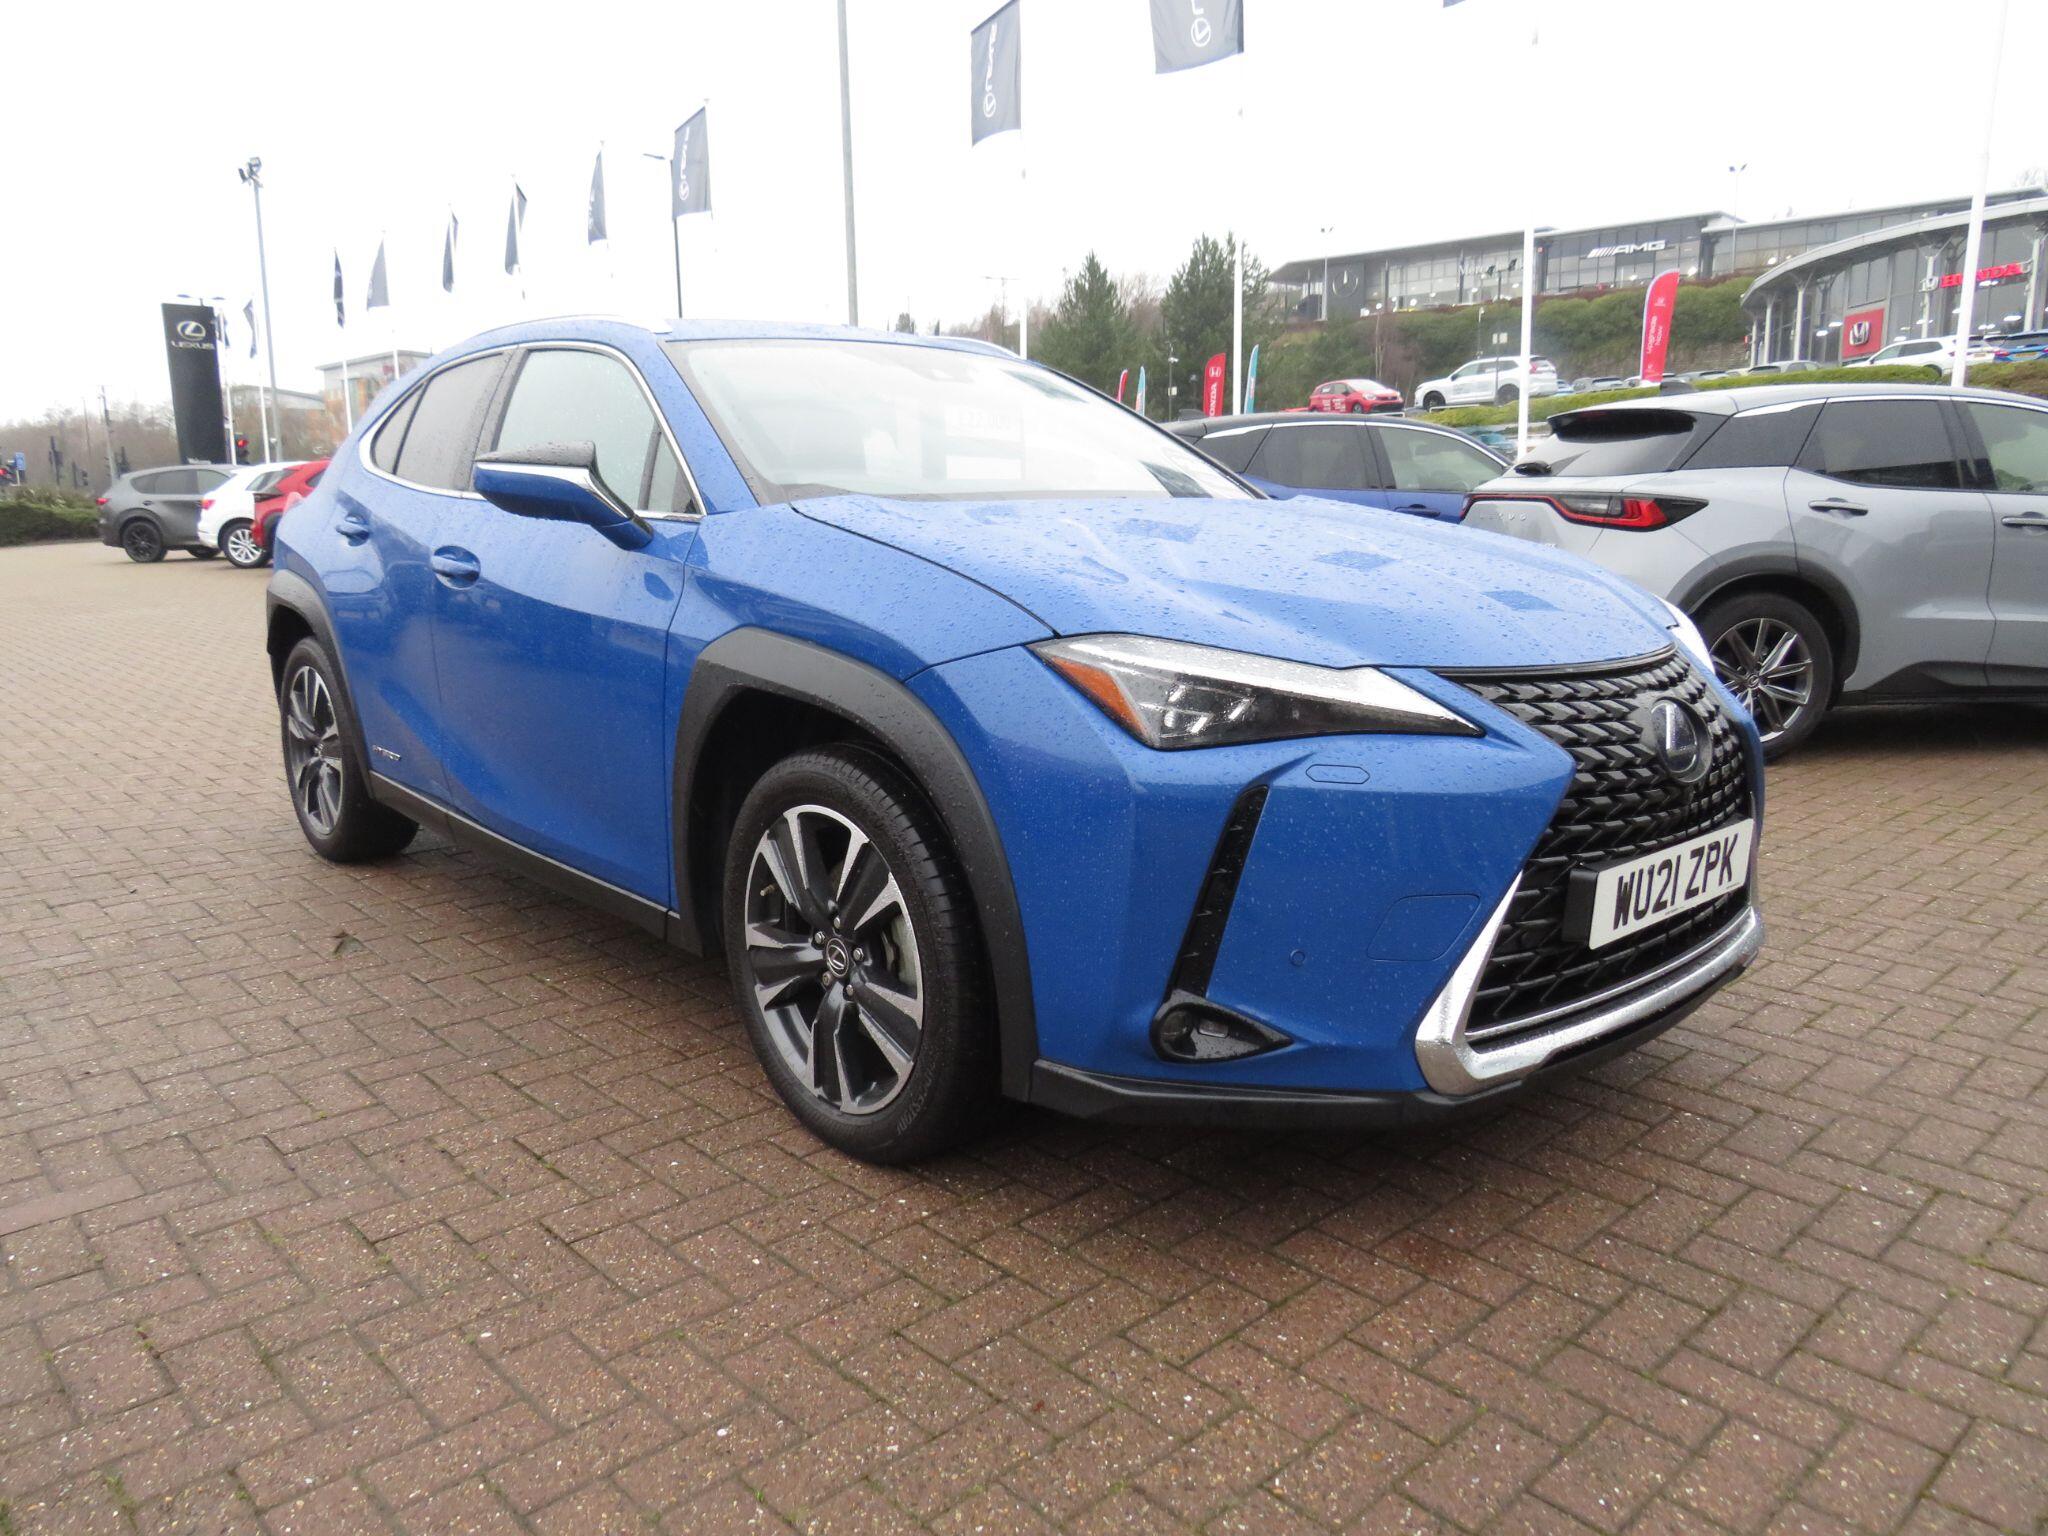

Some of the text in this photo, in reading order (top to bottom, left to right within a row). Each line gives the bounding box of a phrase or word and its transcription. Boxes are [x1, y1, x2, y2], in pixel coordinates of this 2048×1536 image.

[1611, 240, 1666, 256] AMG
[1940, 262, 2025, 289] HNDA
[170, 340, 216, 350] LEXUS
[1208, 382, 1218, 418] ONDA
[1613, 832, 1740, 931] WU21 ZPK
